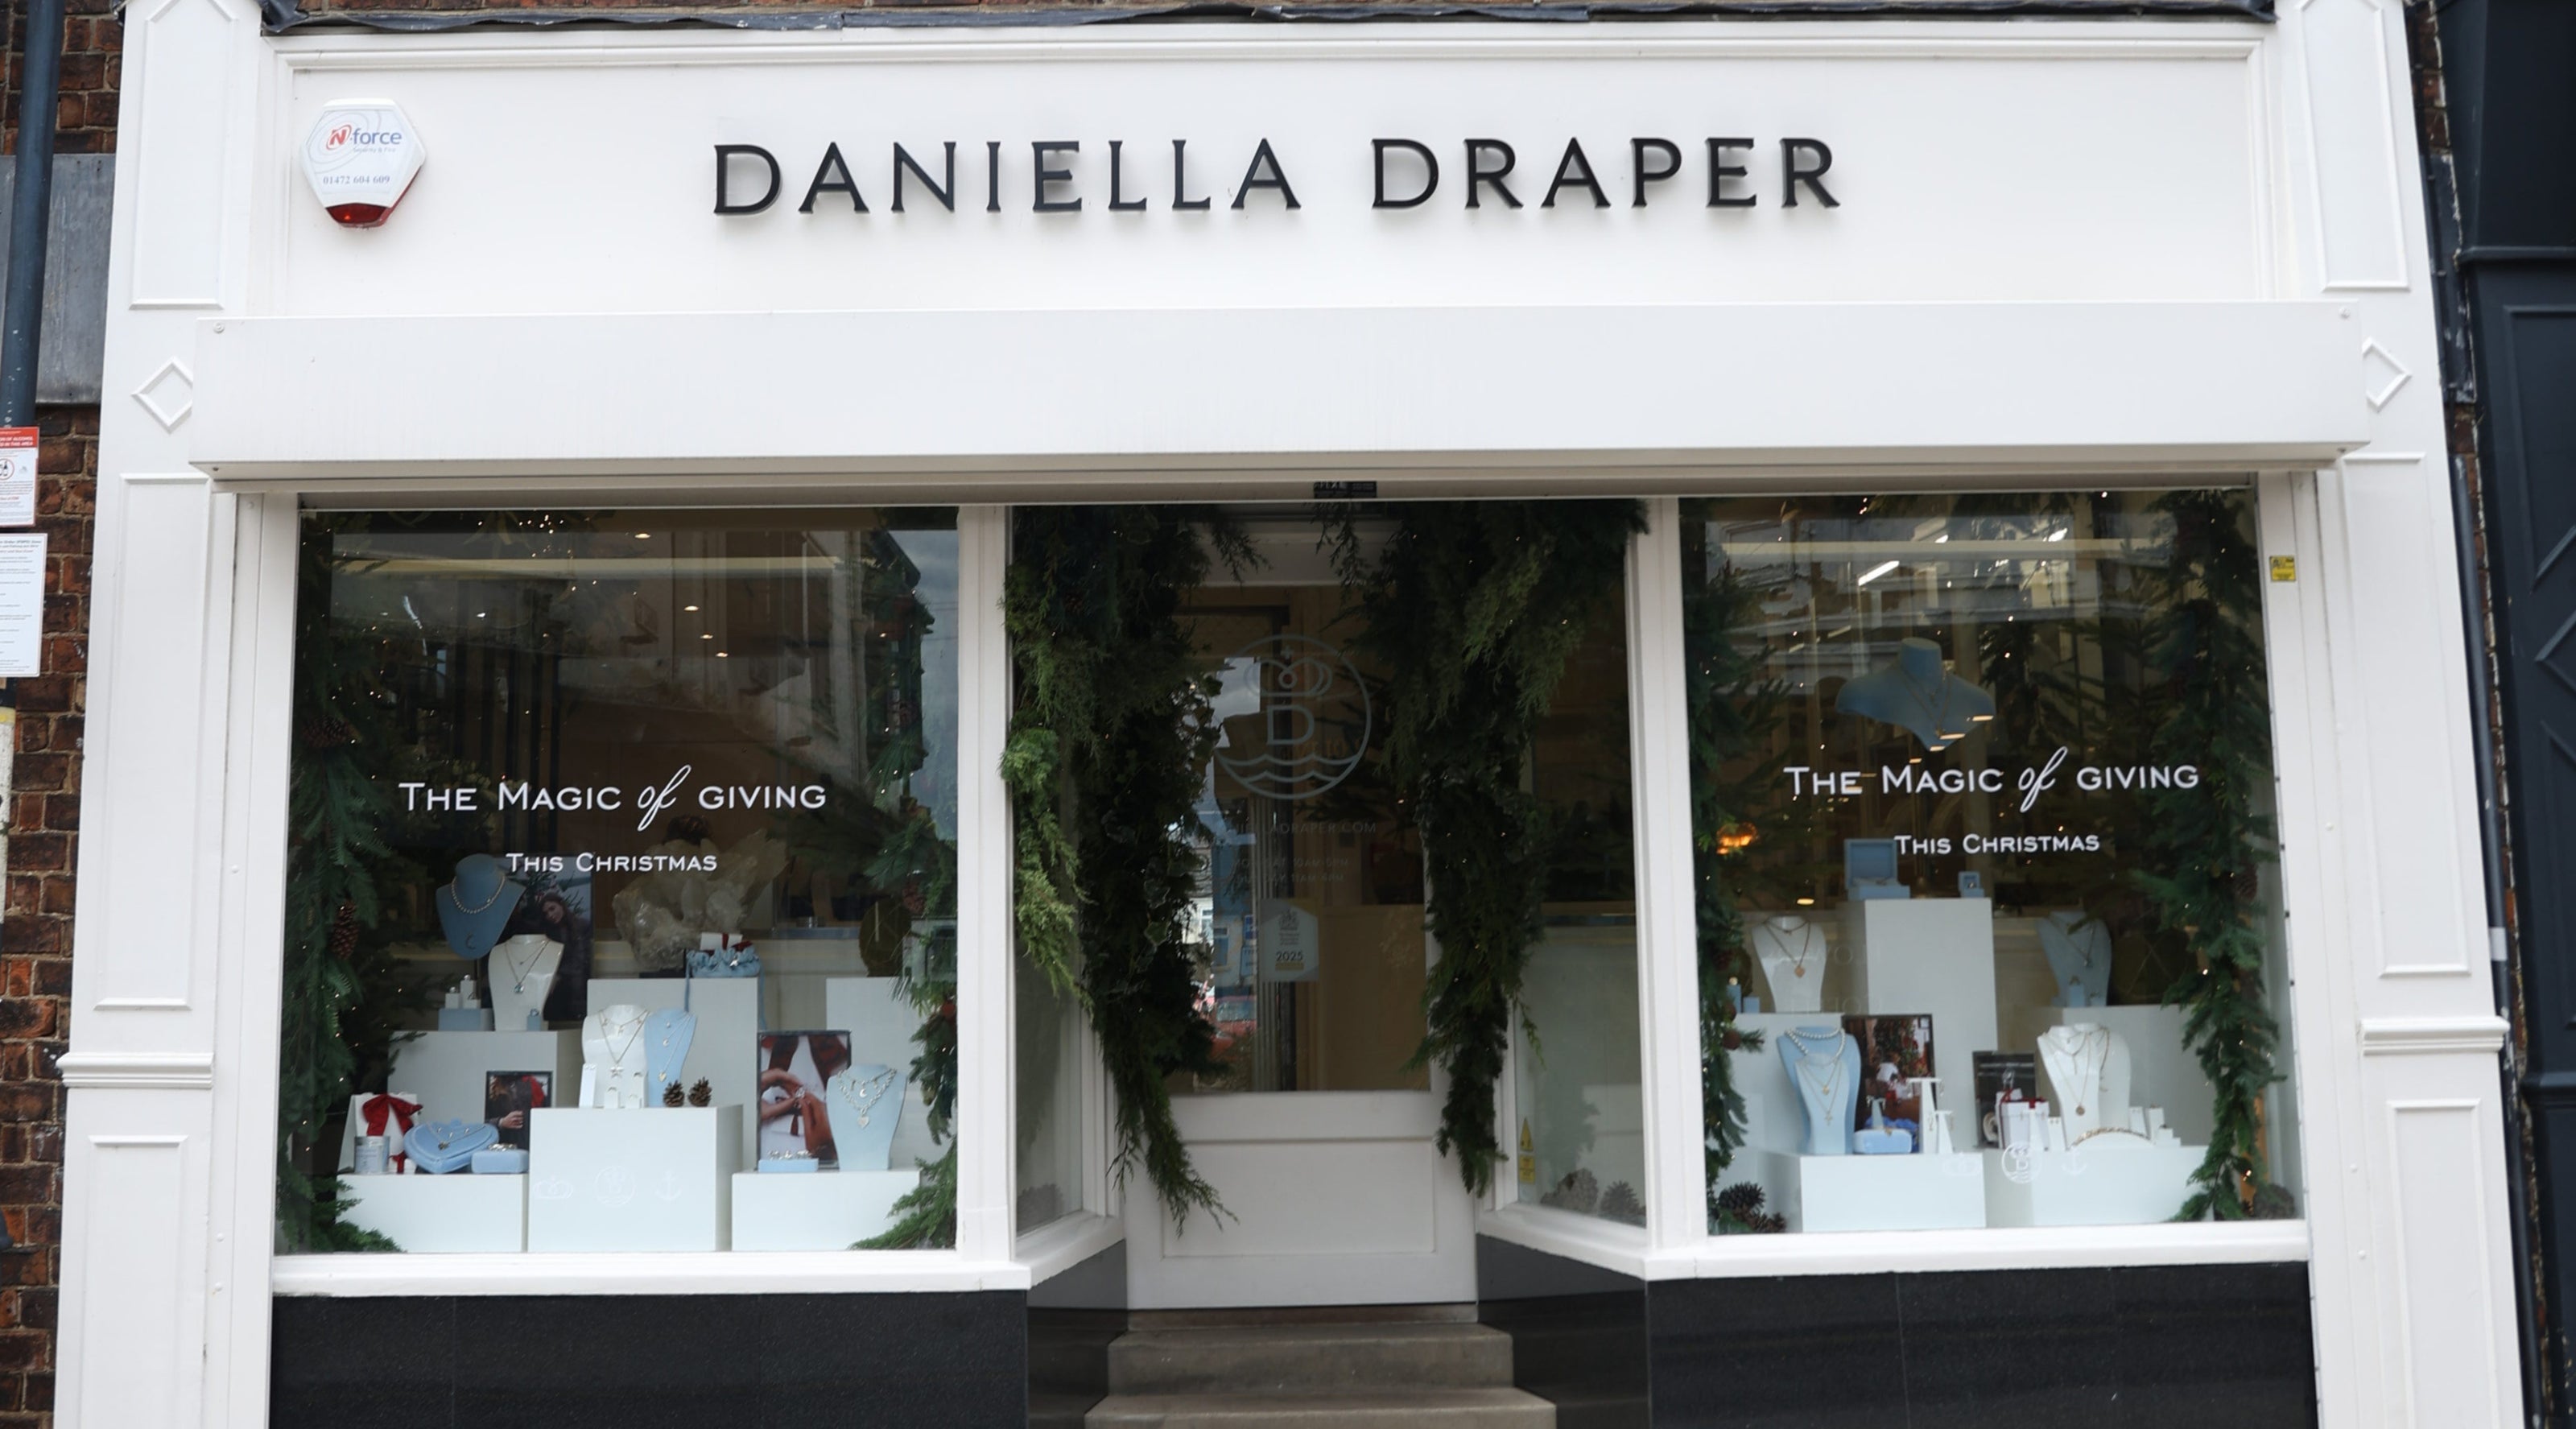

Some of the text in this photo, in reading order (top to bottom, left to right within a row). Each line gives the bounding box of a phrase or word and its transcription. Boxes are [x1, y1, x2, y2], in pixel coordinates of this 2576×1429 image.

[323, 176, 390, 184] 01472 604 609
[713, 137, 1840, 214] DANIELLA DRAPER
[638, 765, 691, 831] of
[2019, 746, 2067, 812] of
[1275, 950, 1304, 962] 2025
